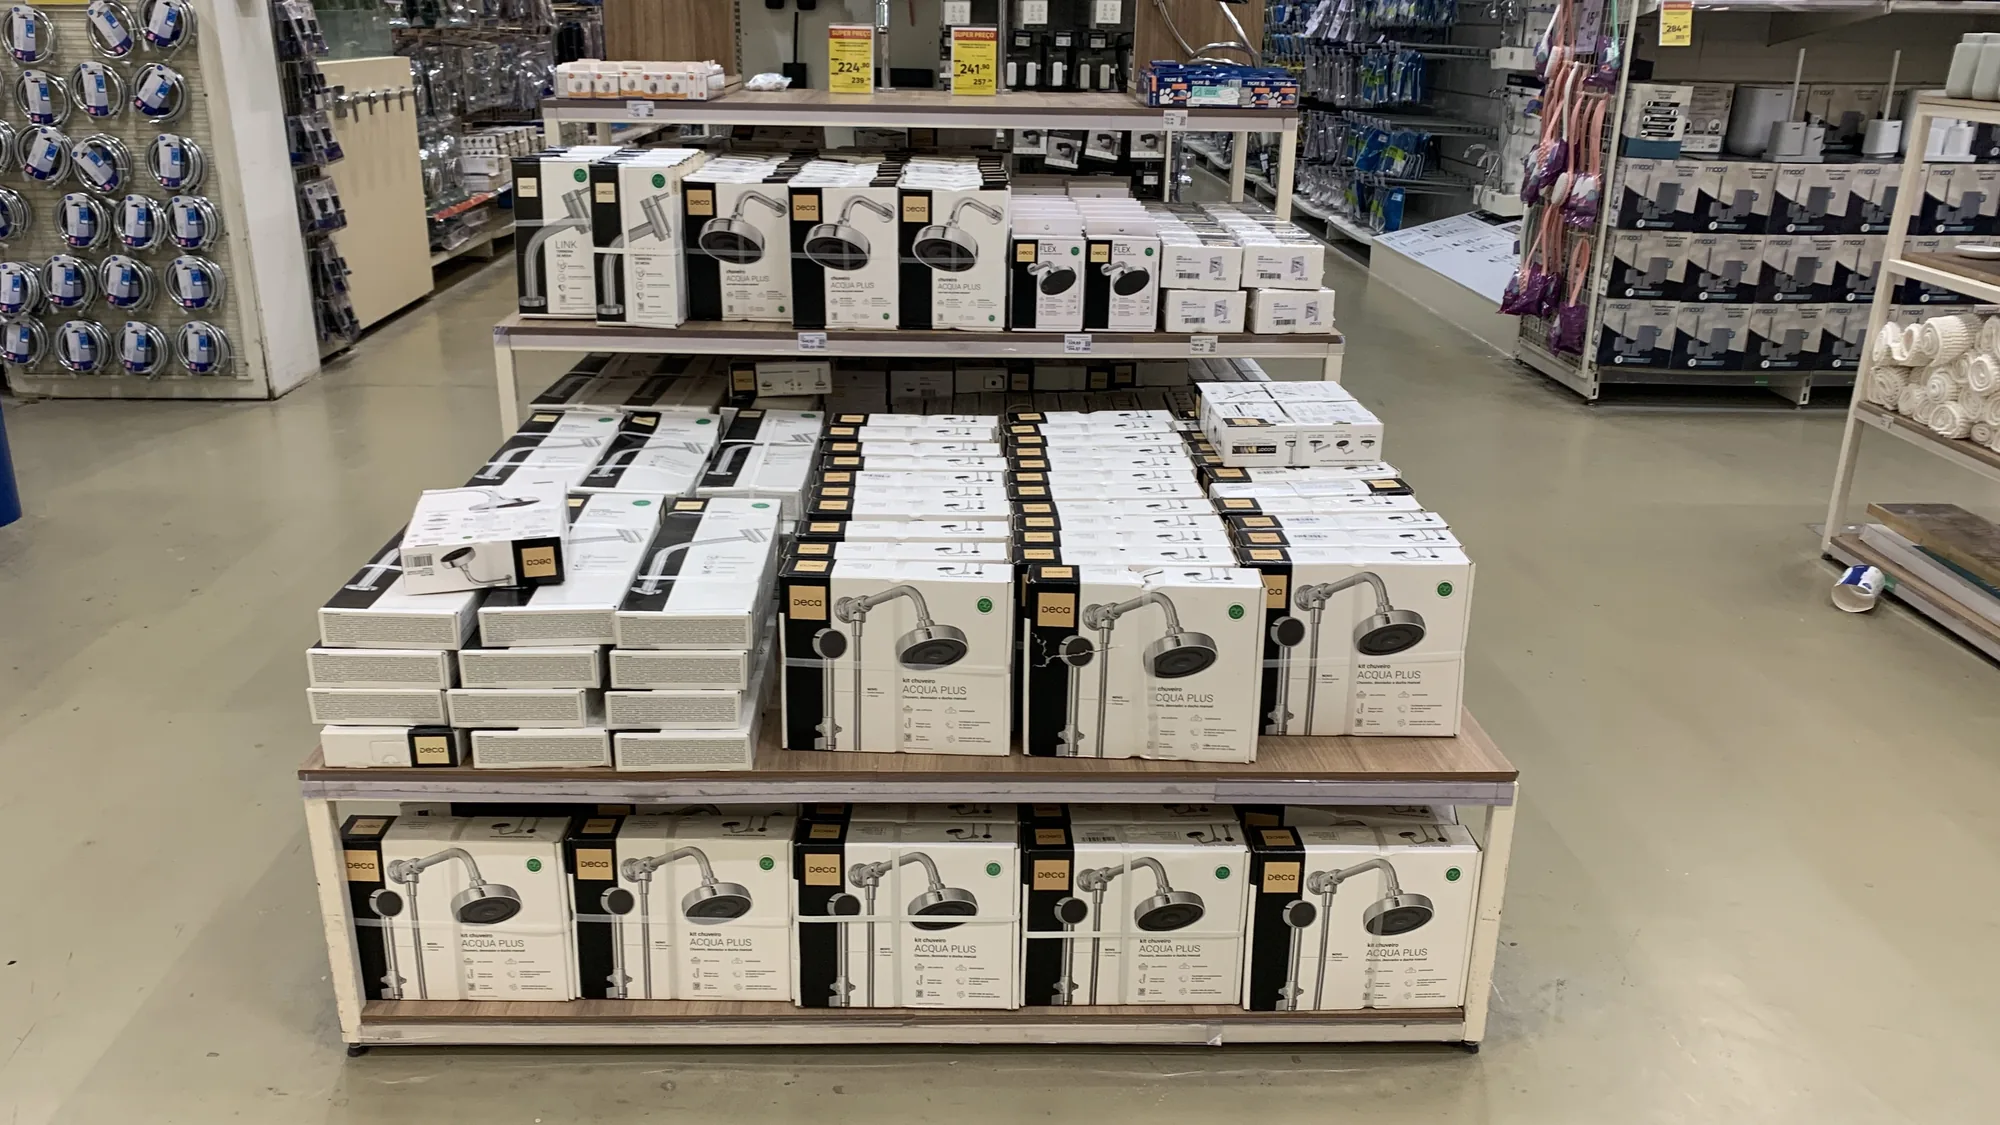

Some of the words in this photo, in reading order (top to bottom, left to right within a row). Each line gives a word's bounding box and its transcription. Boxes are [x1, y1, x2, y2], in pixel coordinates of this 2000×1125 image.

[1933, 168, 1956, 176] mood
[555, 241, 577, 249] LINK
[1268, 587, 1283, 595] ca
[794, 598, 822, 607] Deca
[1042, 606, 1070, 614] Deca
[1357, 670, 1392, 680] ACQUA
[1395, 670, 1421, 679] PLUS
[903, 685, 938, 695] ACQUA
[940, 686, 967, 695] PLUS
[1152, 694, 1184, 703] CQUA
[1187, 694, 1213, 703] PLUS
[461, 940, 496, 948] ACQUA
[690, 938, 724, 948] ACQUA
[727, 939, 752, 947] PLUS
[915, 945, 948, 954] ACQUA
[951, 945, 976, 954] PLUS
[1139, 945, 1172, 954] ACQUA
[1366, 949, 1400, 957] ACQUA
[1403, 948, 1427, 956] PLUS
